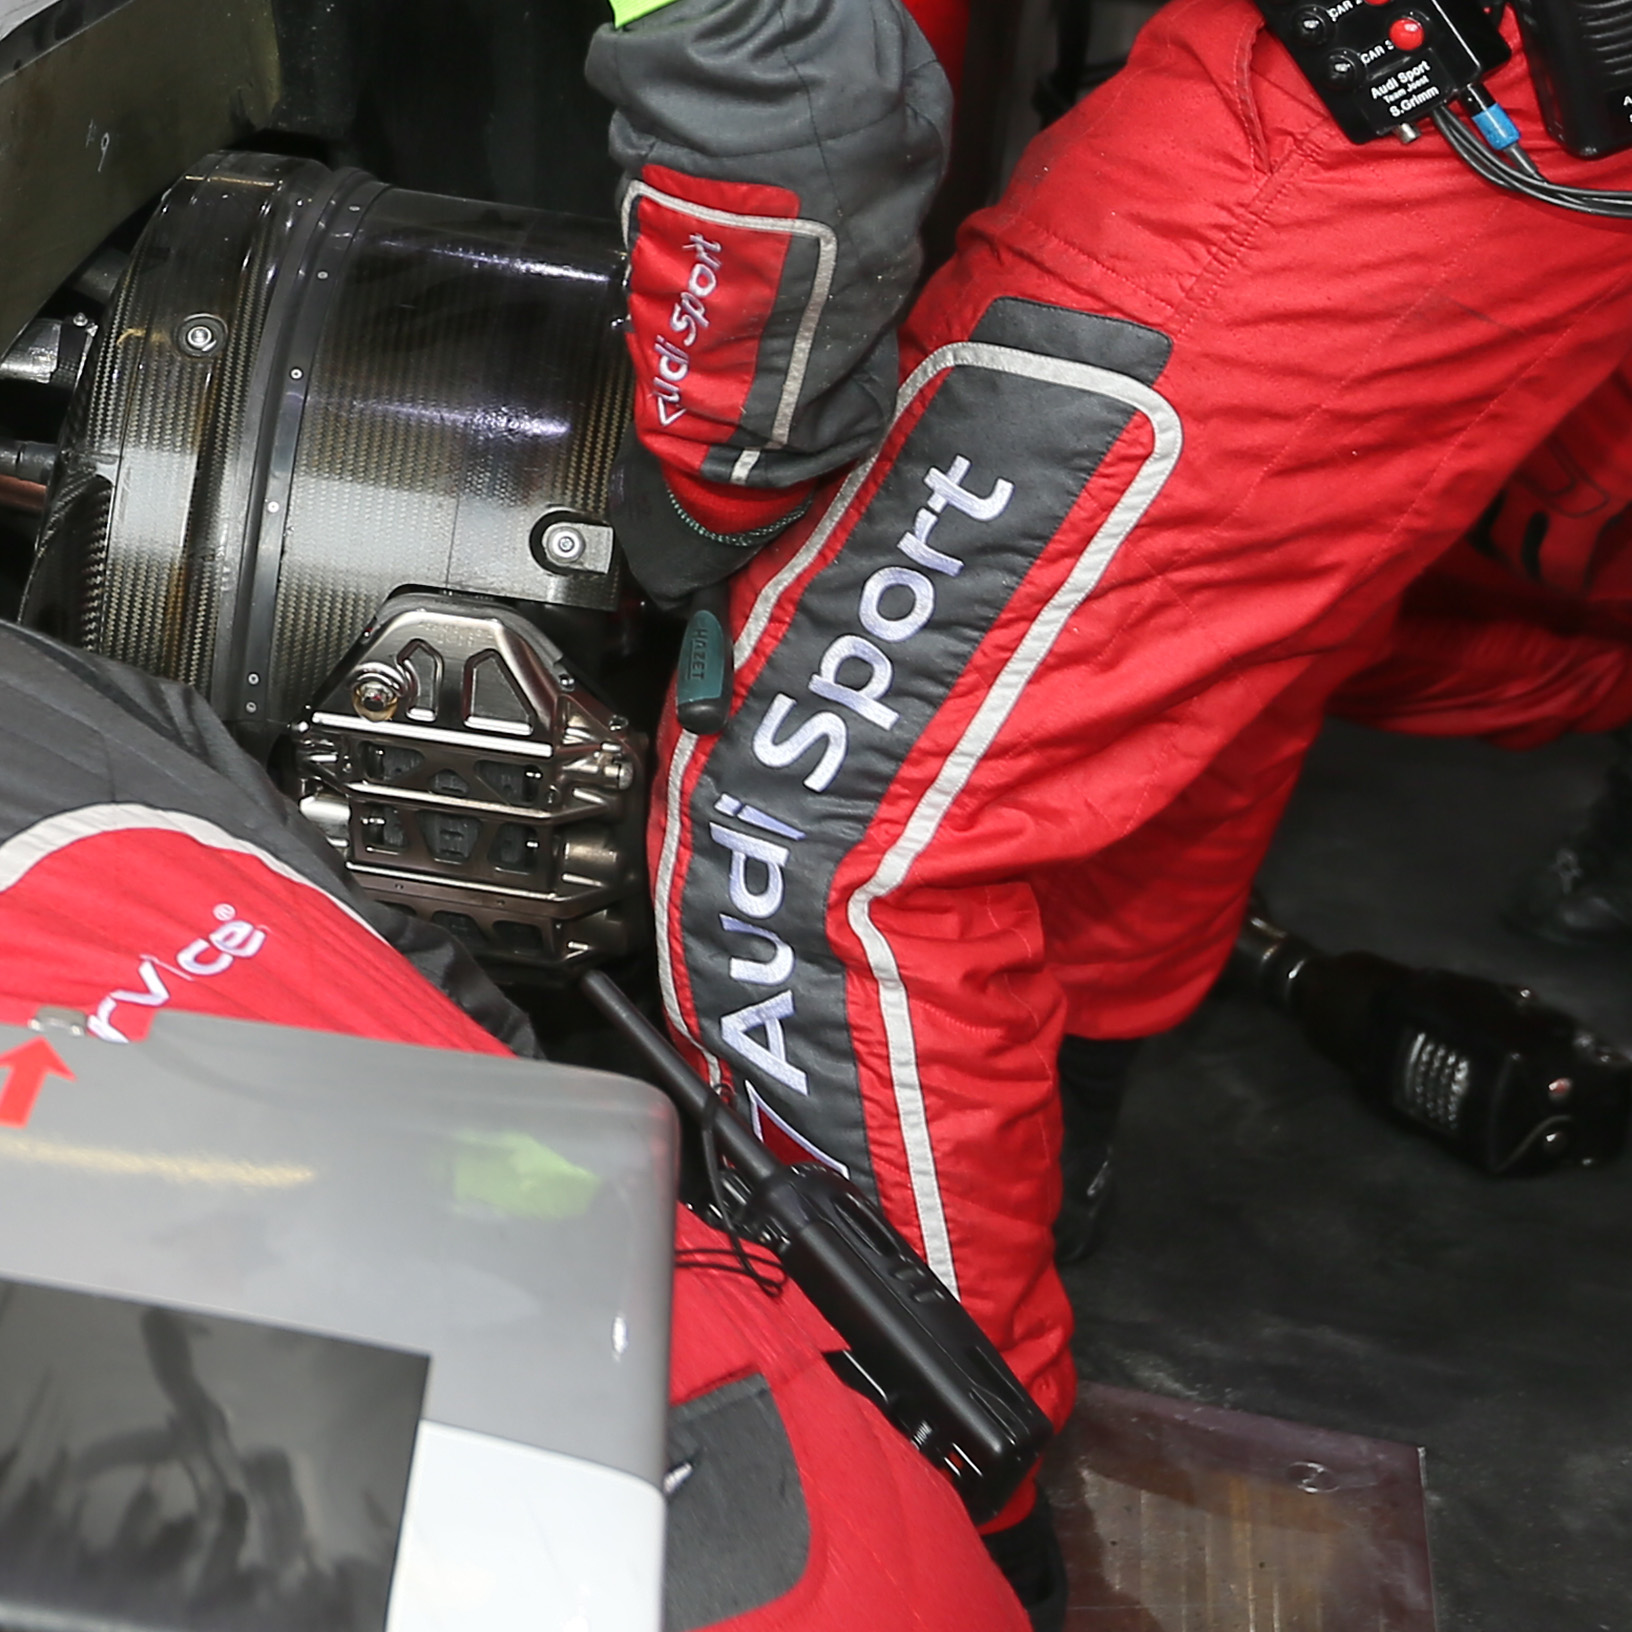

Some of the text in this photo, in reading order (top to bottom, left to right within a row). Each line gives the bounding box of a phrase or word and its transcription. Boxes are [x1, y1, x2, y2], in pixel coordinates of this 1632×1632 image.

[1328, 0, 1354, 20] CAR
[1359, 44, 1386, 66] CAR
[1370, 60, 1431, 100] Audi Sport
[692, 626, 712, 684] HAZET
[710, 453, 1016, 1096] Audi Sport
